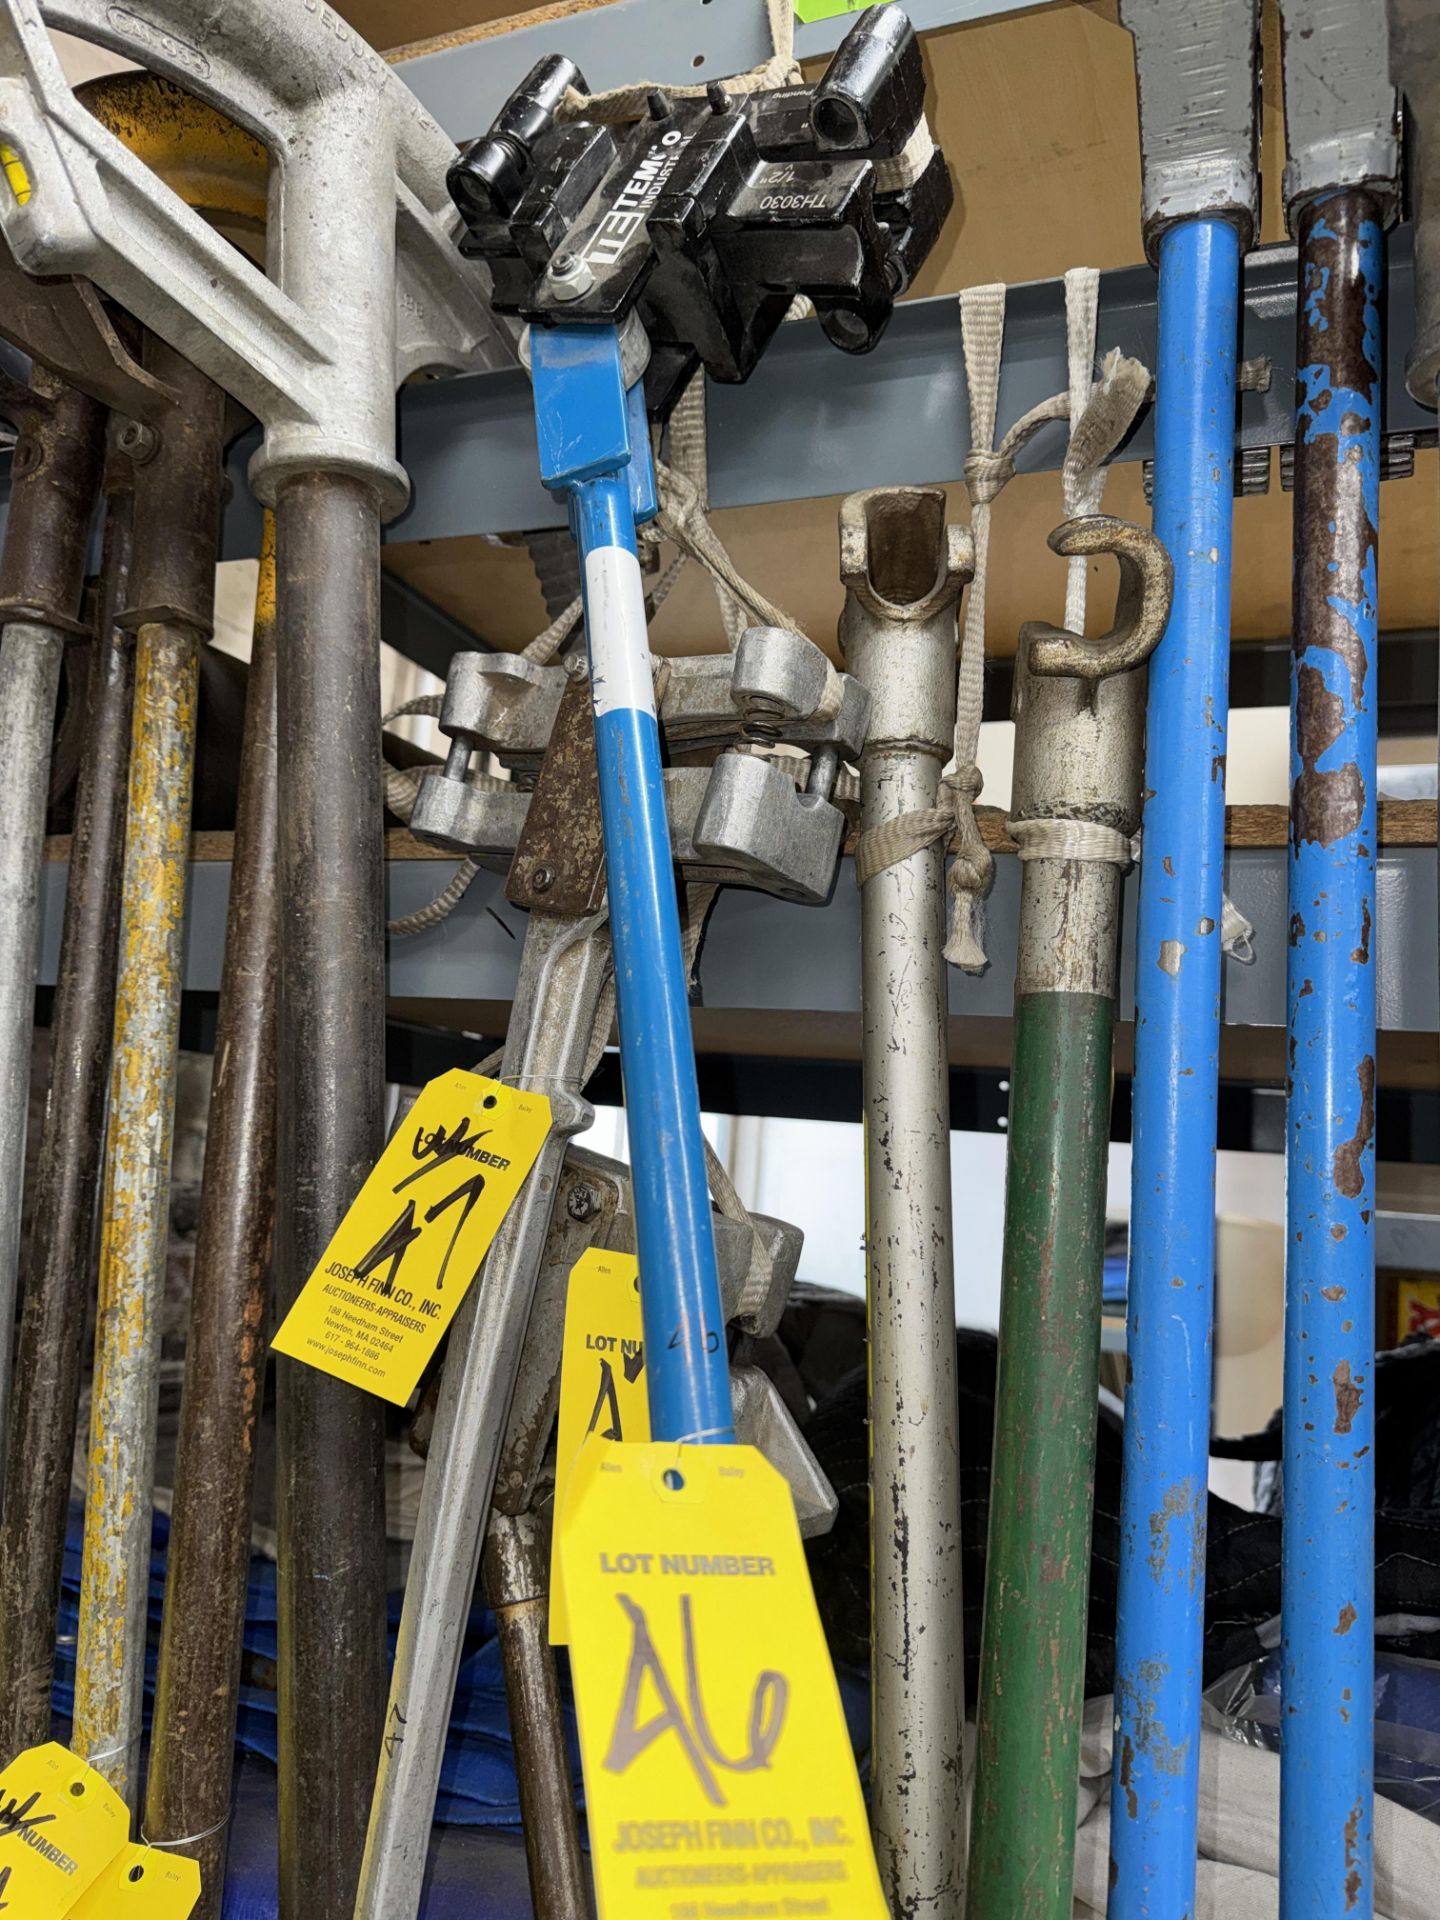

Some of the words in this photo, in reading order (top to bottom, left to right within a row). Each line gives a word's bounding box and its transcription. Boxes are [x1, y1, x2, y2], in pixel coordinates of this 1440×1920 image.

[760, 194, 827, 209] TH3030
[322, 1284, 427, 1333] AUCTIONEERS-APPRAISERS
[325, 1262, 368, 1288] JOSEPH
[367, 1277, 396, 1299] FINN
[394, 1289, 416, 1312] CO.,
[418, 1298, 441, 1320] INC.
[324, 1317, 354, 1337] Newton,
[355, 1330, 369, 1342] MA
[369, 1336, 394, 1352] 02464
[328, 1305, 341, 1316] 188
[342, 1311, 379, 1332] Needham
[379, 1327, 404, 1343] Street
[586, 1334, 617, 1351] LOT
[307, 1336, 386, 1378] www.josephfinn.com
[325, 1331, 339, 1343] 617
[345, 1339, 380, 1360] 964-1886
[600, 1552, 654, 1574] LOT
[661, 1555, 776, 1576] NUMBER
[17, 1826, 78, 1876] NUMBER
[613, 1820, 700, 1853] JOSEPH
[705, 1818, 758, 1850] FINN
[809, 1816, 854, 1848] INC.
